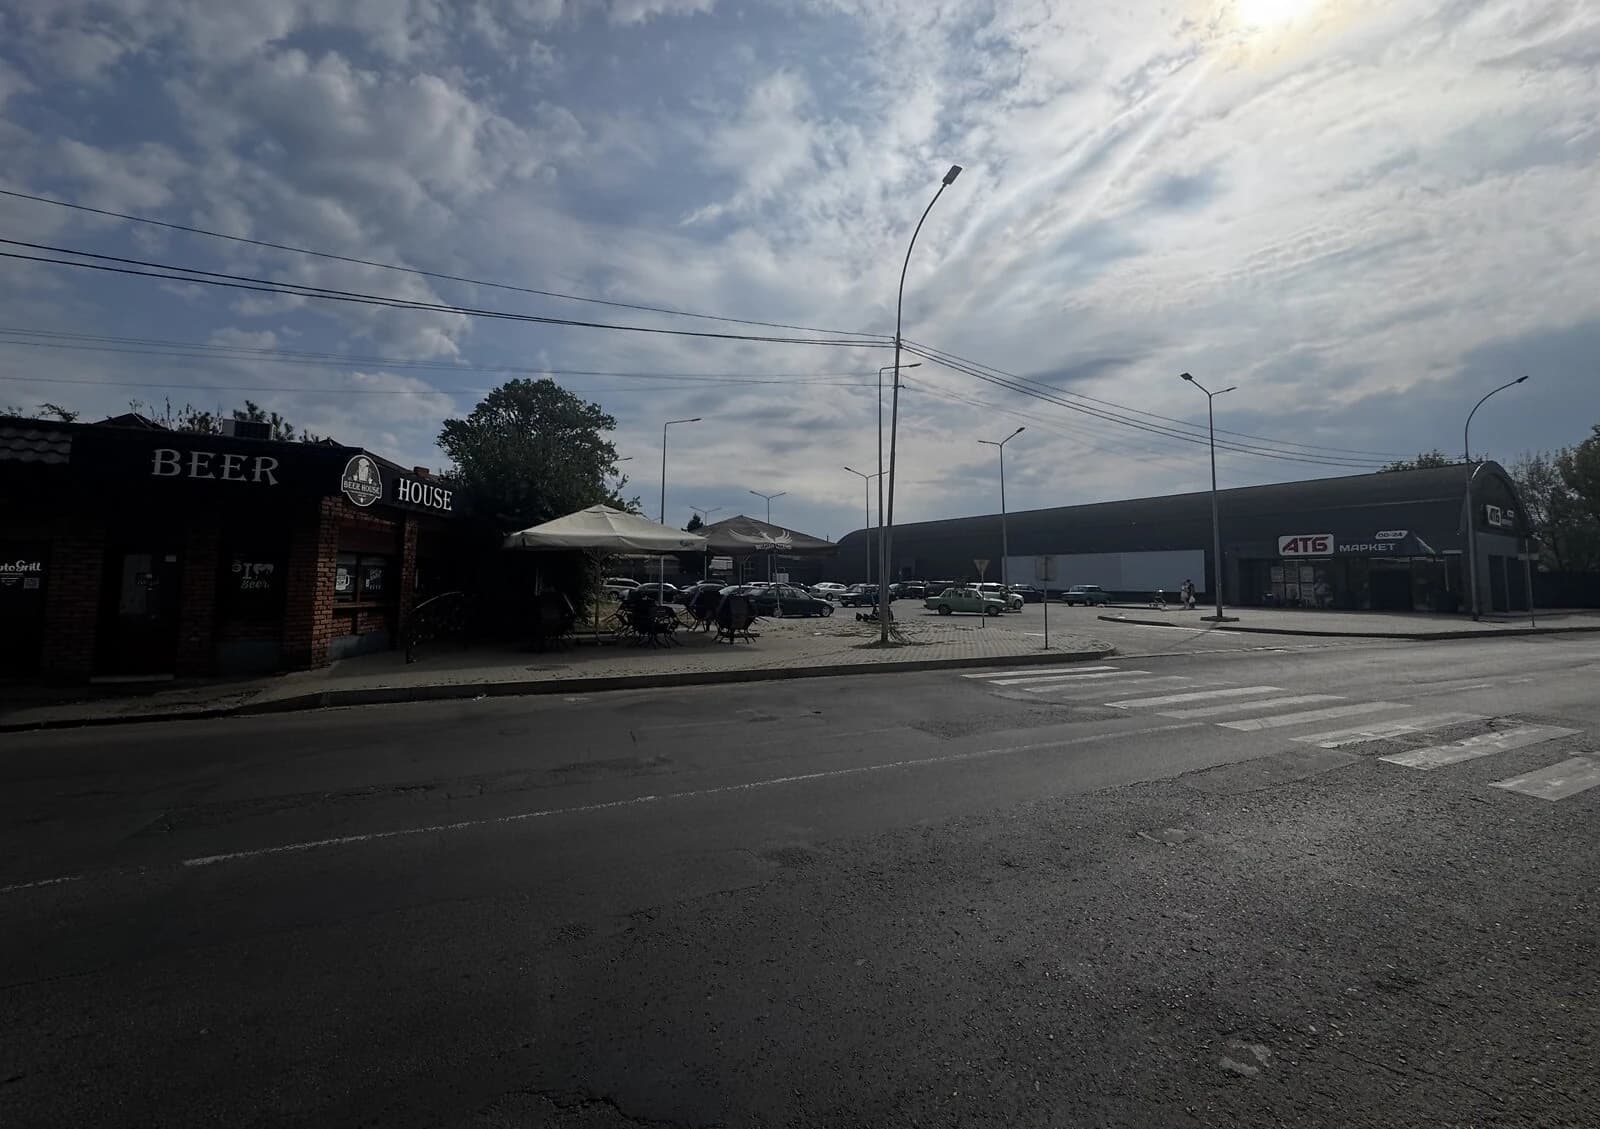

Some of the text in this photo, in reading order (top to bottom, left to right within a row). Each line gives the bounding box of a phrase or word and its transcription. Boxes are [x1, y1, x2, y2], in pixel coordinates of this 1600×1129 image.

[151, 448, 279, 485] BEER
[344, 480, 360, 490] BEER
[398, 477, 453, 511] HOUSE
[1339, 543, 1395, 552] МАРКЕТ
